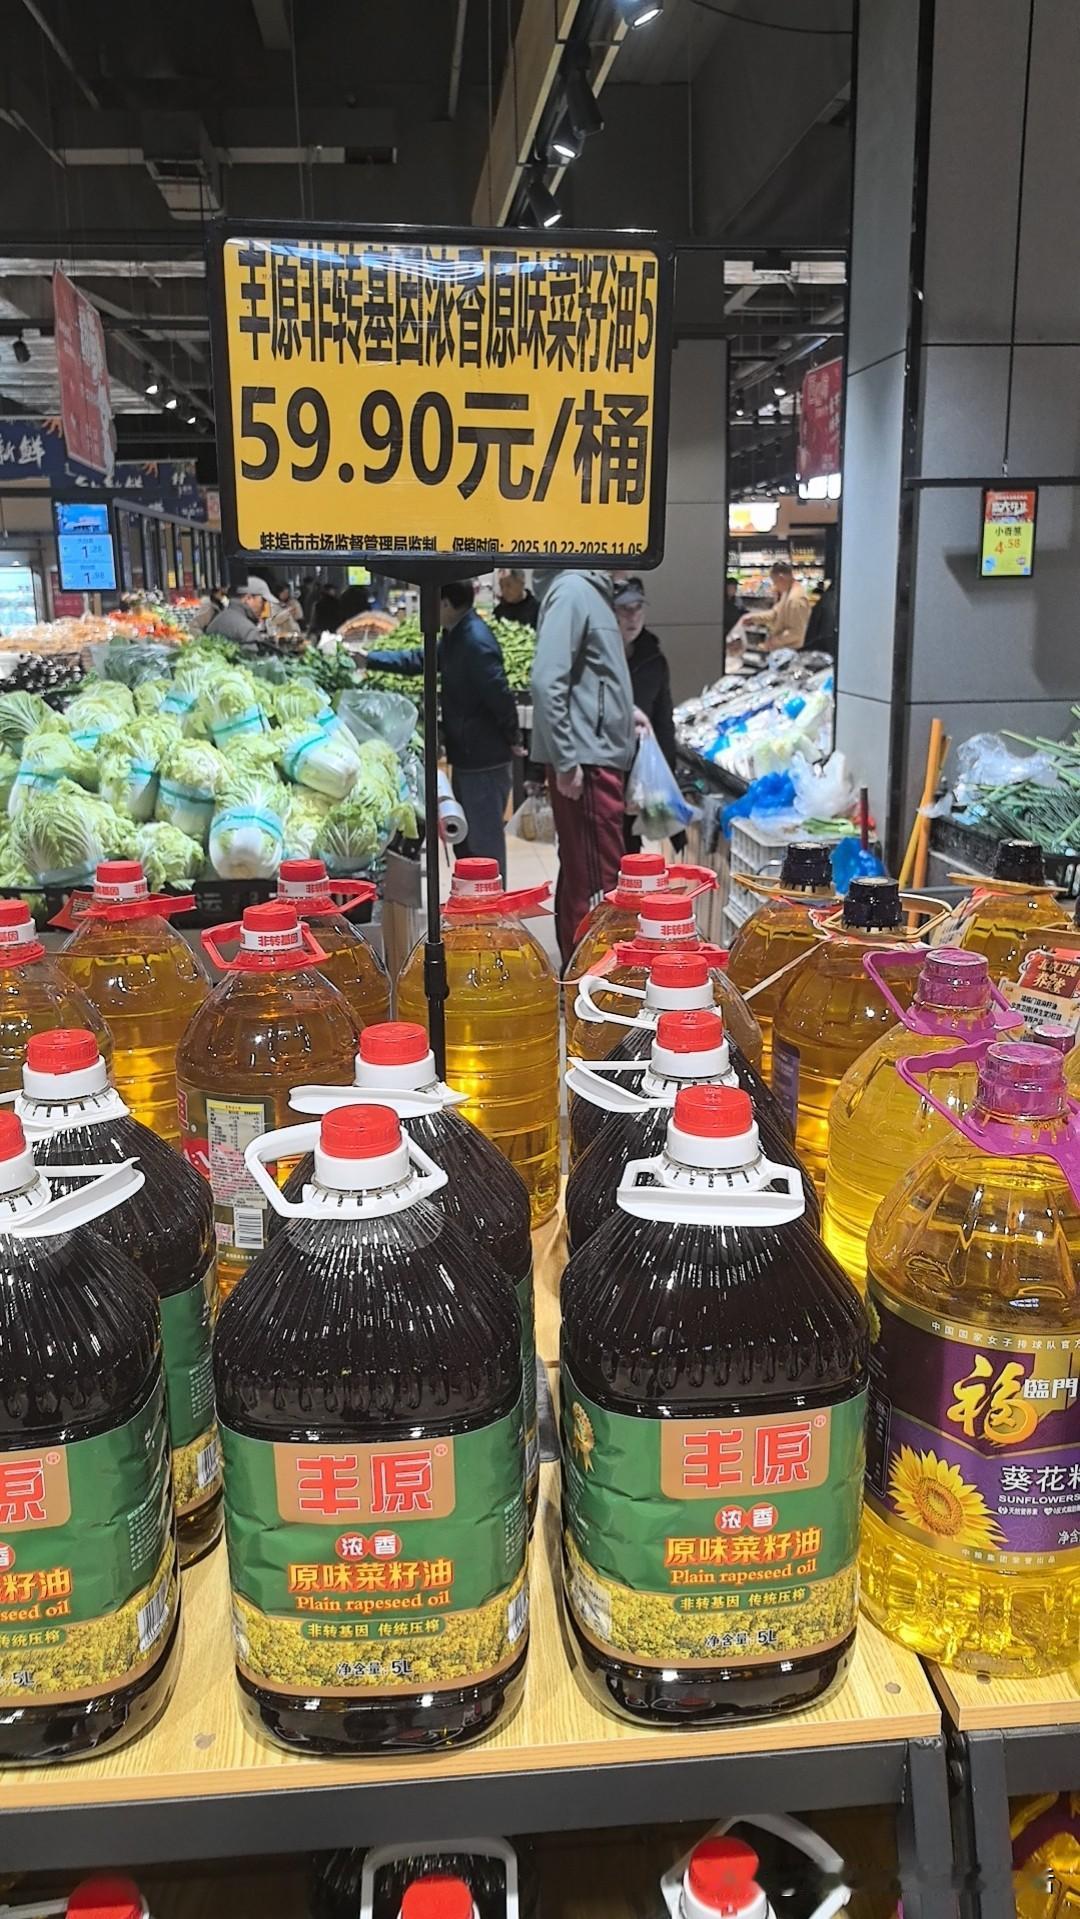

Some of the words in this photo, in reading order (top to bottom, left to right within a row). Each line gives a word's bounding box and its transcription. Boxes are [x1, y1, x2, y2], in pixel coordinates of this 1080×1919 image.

[238, 240, 657, 373] 丰原非转基因浓香原味菜籽油5
[241, 386, 649, 505] 59.90元/桶
[260, 532, 437, 550] 蚌埠市市场监督管理局监制
[257, 932, 298, 946] 非转基因
[684, 1421, 812, 1489] 丰原
[297, 1450, 433, 1516] 丰原
[721, 1506, 775, 1529] 浓香
[341, 1534, 397, 1557] 浓香
[665, 1527, 822, 1566] 原味菜籽油
[288, 1558, 454, 1594] 原味菜籽油
[671, 1569, 715, 1585] Plain
[720, 1563, 792, 1586] rapeseed
[797, 1558, 817, 1574] oil
[45, 1599, 70, 1616] oil
[296, 1595, 341, 1612] Plain
[346, 1593, 422, 1614] rapeseed
[428, 1590, 450, 1605] oil
[680, 1595, 741, 1611] 非转基因
[748, 1587, 806, 1608] 传统压榨
[307, 1622, 369, 1639] 非转基因
[377, 1619, 440, 1638] 传统压榨
[757, 1631, 777, 1644] 5L
[391, 1660, 413, 1675] 5L
